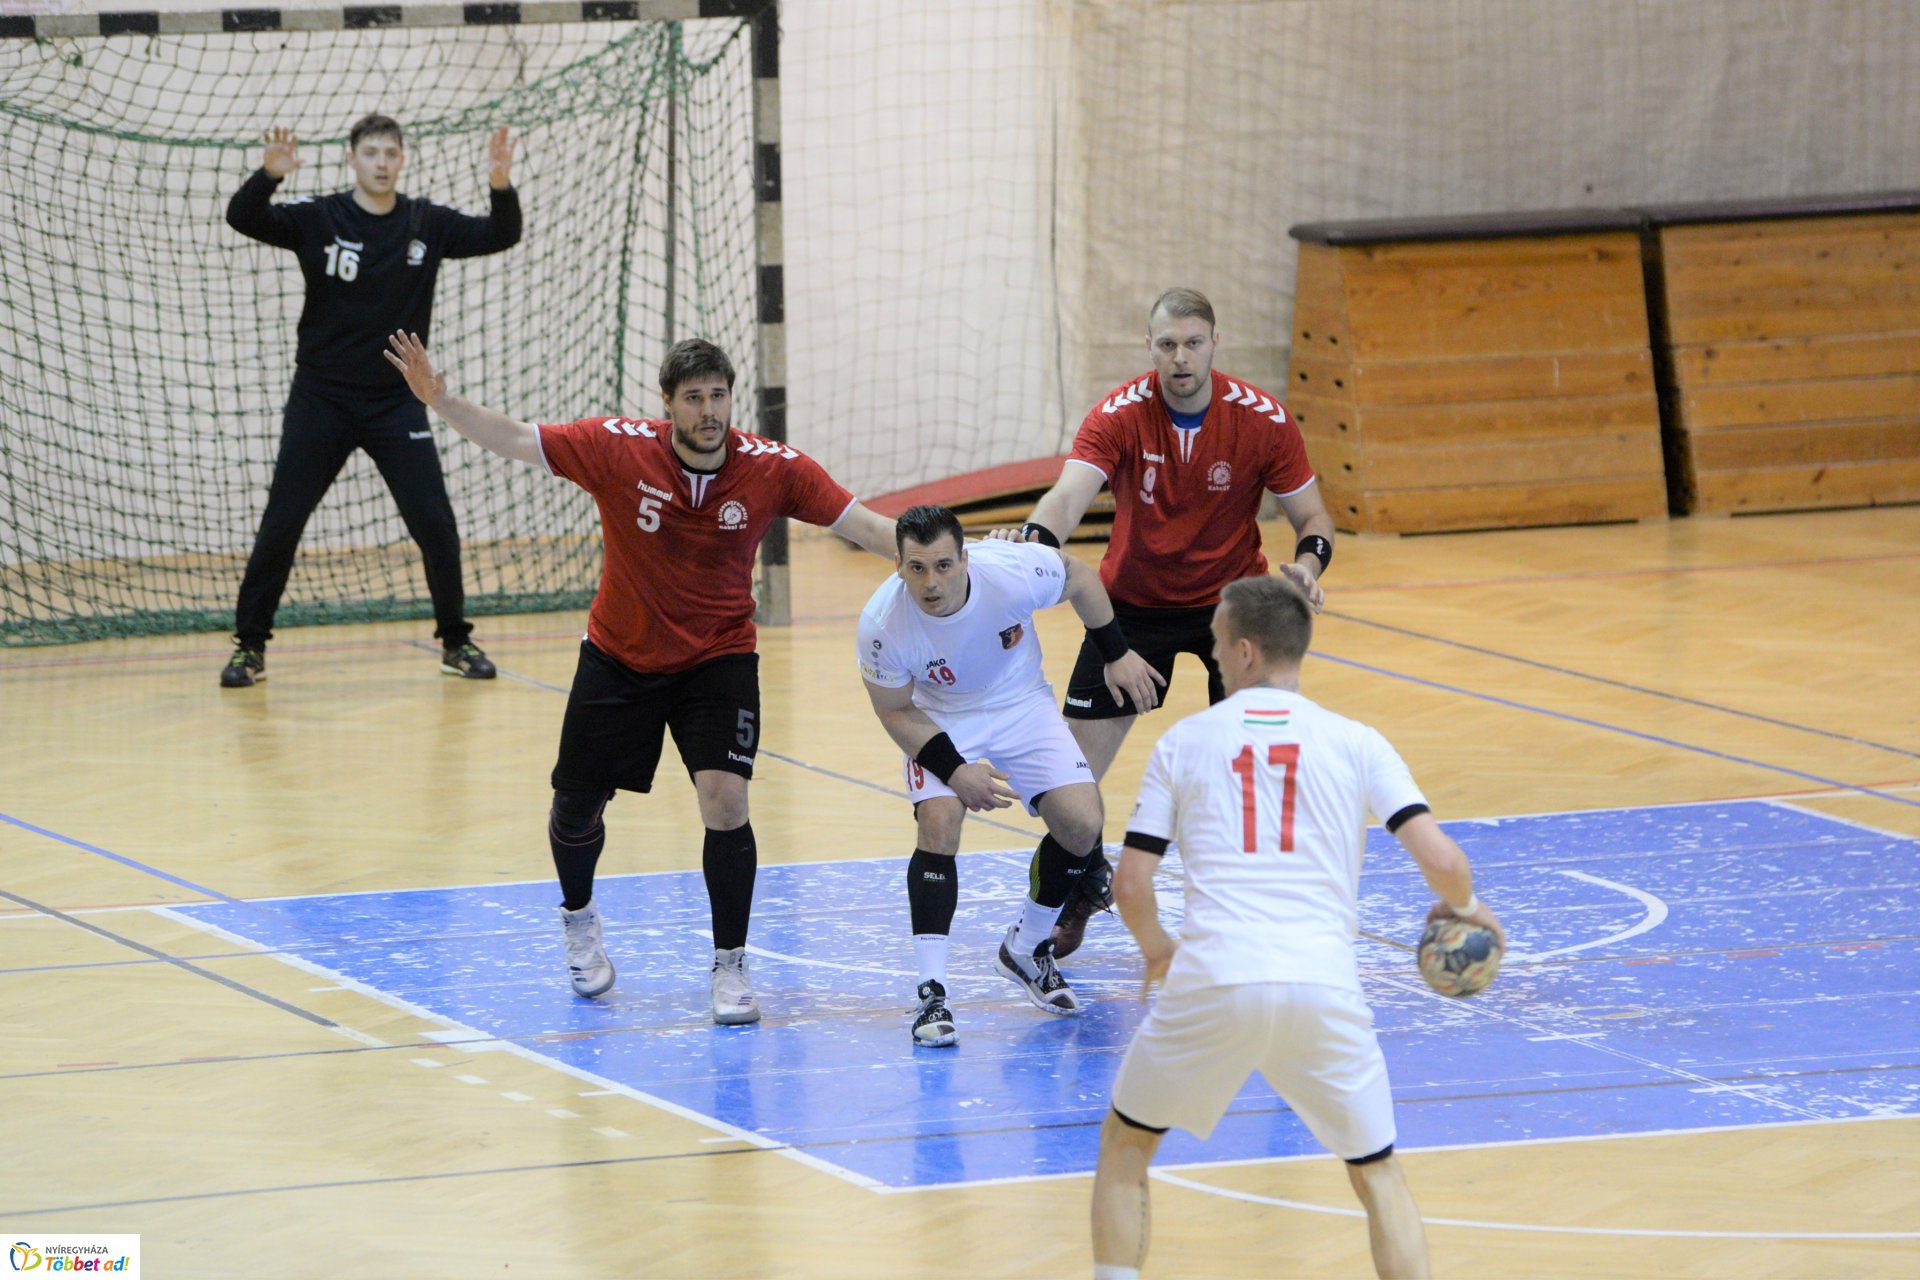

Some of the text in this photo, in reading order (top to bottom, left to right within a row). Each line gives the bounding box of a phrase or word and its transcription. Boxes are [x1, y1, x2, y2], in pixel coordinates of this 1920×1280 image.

[324, 243, 361, 282] 16
[637, 480, 673, 502] hummel
[1139, 466, 1156, 505] 9
[637, 496, 662, 533] 5
[926, 658, 946, 670] JAKO
[928, 666, 957, 686] 19
[736, 708, 755, 749] 5
[1232, 744, 1300, 853] 17
